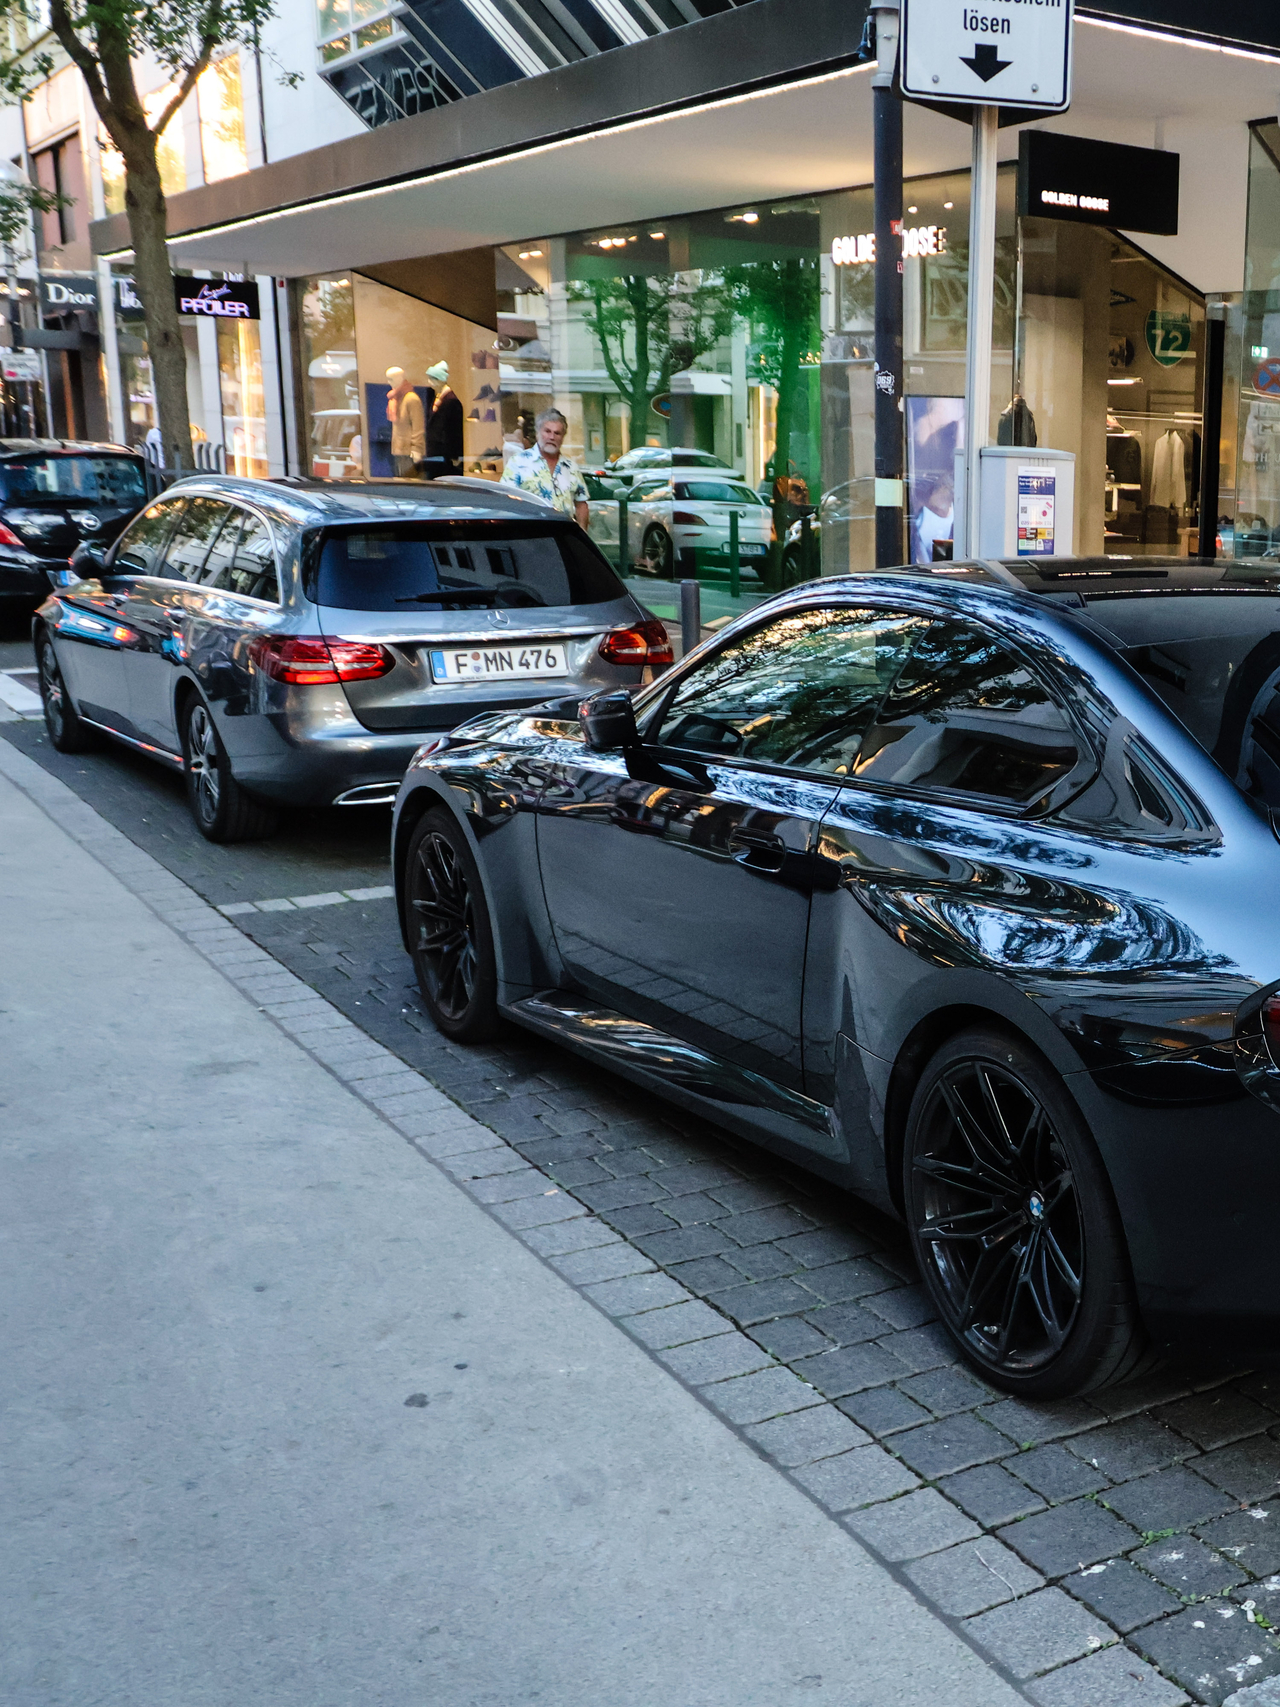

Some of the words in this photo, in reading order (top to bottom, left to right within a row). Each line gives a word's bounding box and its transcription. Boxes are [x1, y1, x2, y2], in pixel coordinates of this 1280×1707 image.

[963, 9, 1011, 34] lösen
[1041, 190, 1077, 207] GOLDEN
[1079, 195, 1110, 212] GOOSE
[831, 232, 877, 266] GOLDE
[45, 282, 97, 306] Dior
[454, 653, 468, 674] F
[483, 650, 514, 672] MN
[518, 648, 557, 669] 476
